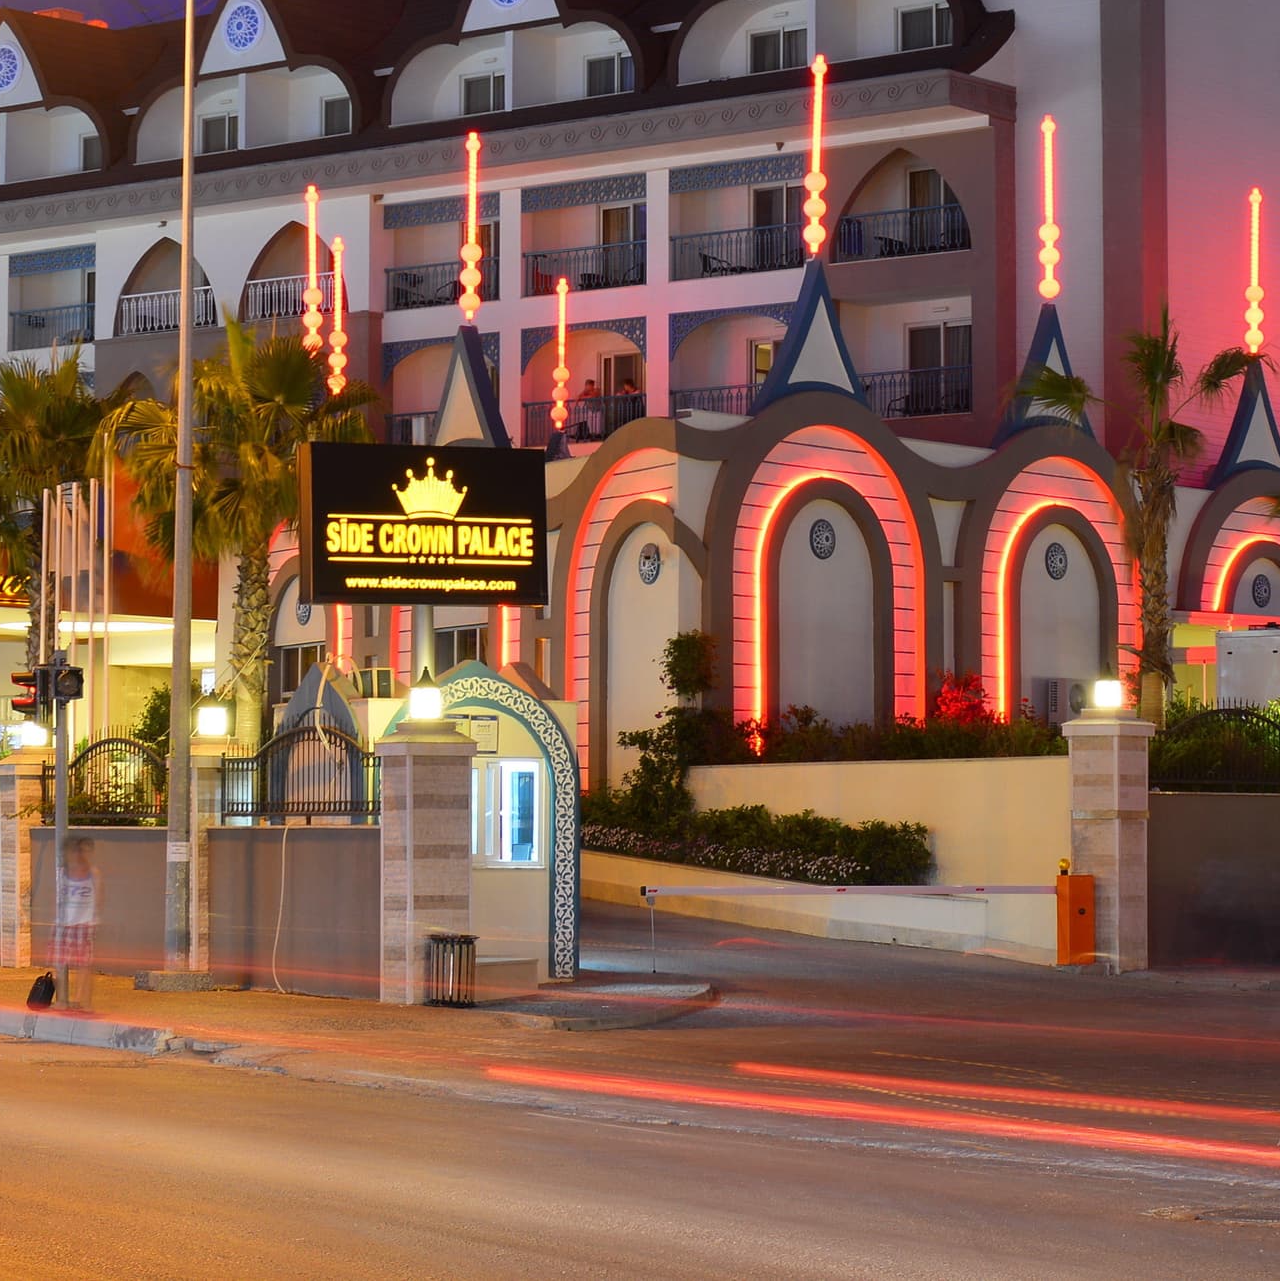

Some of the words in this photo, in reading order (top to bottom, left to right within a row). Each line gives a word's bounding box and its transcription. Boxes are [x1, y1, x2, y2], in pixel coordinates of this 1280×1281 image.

[325, 517, 375, 553] SİDE
[378, 523, 454, 555] CROWN
[457, 525, 534, 557] PALACE
[345, 576, 517, 592] www.sidecrownpalace.com
